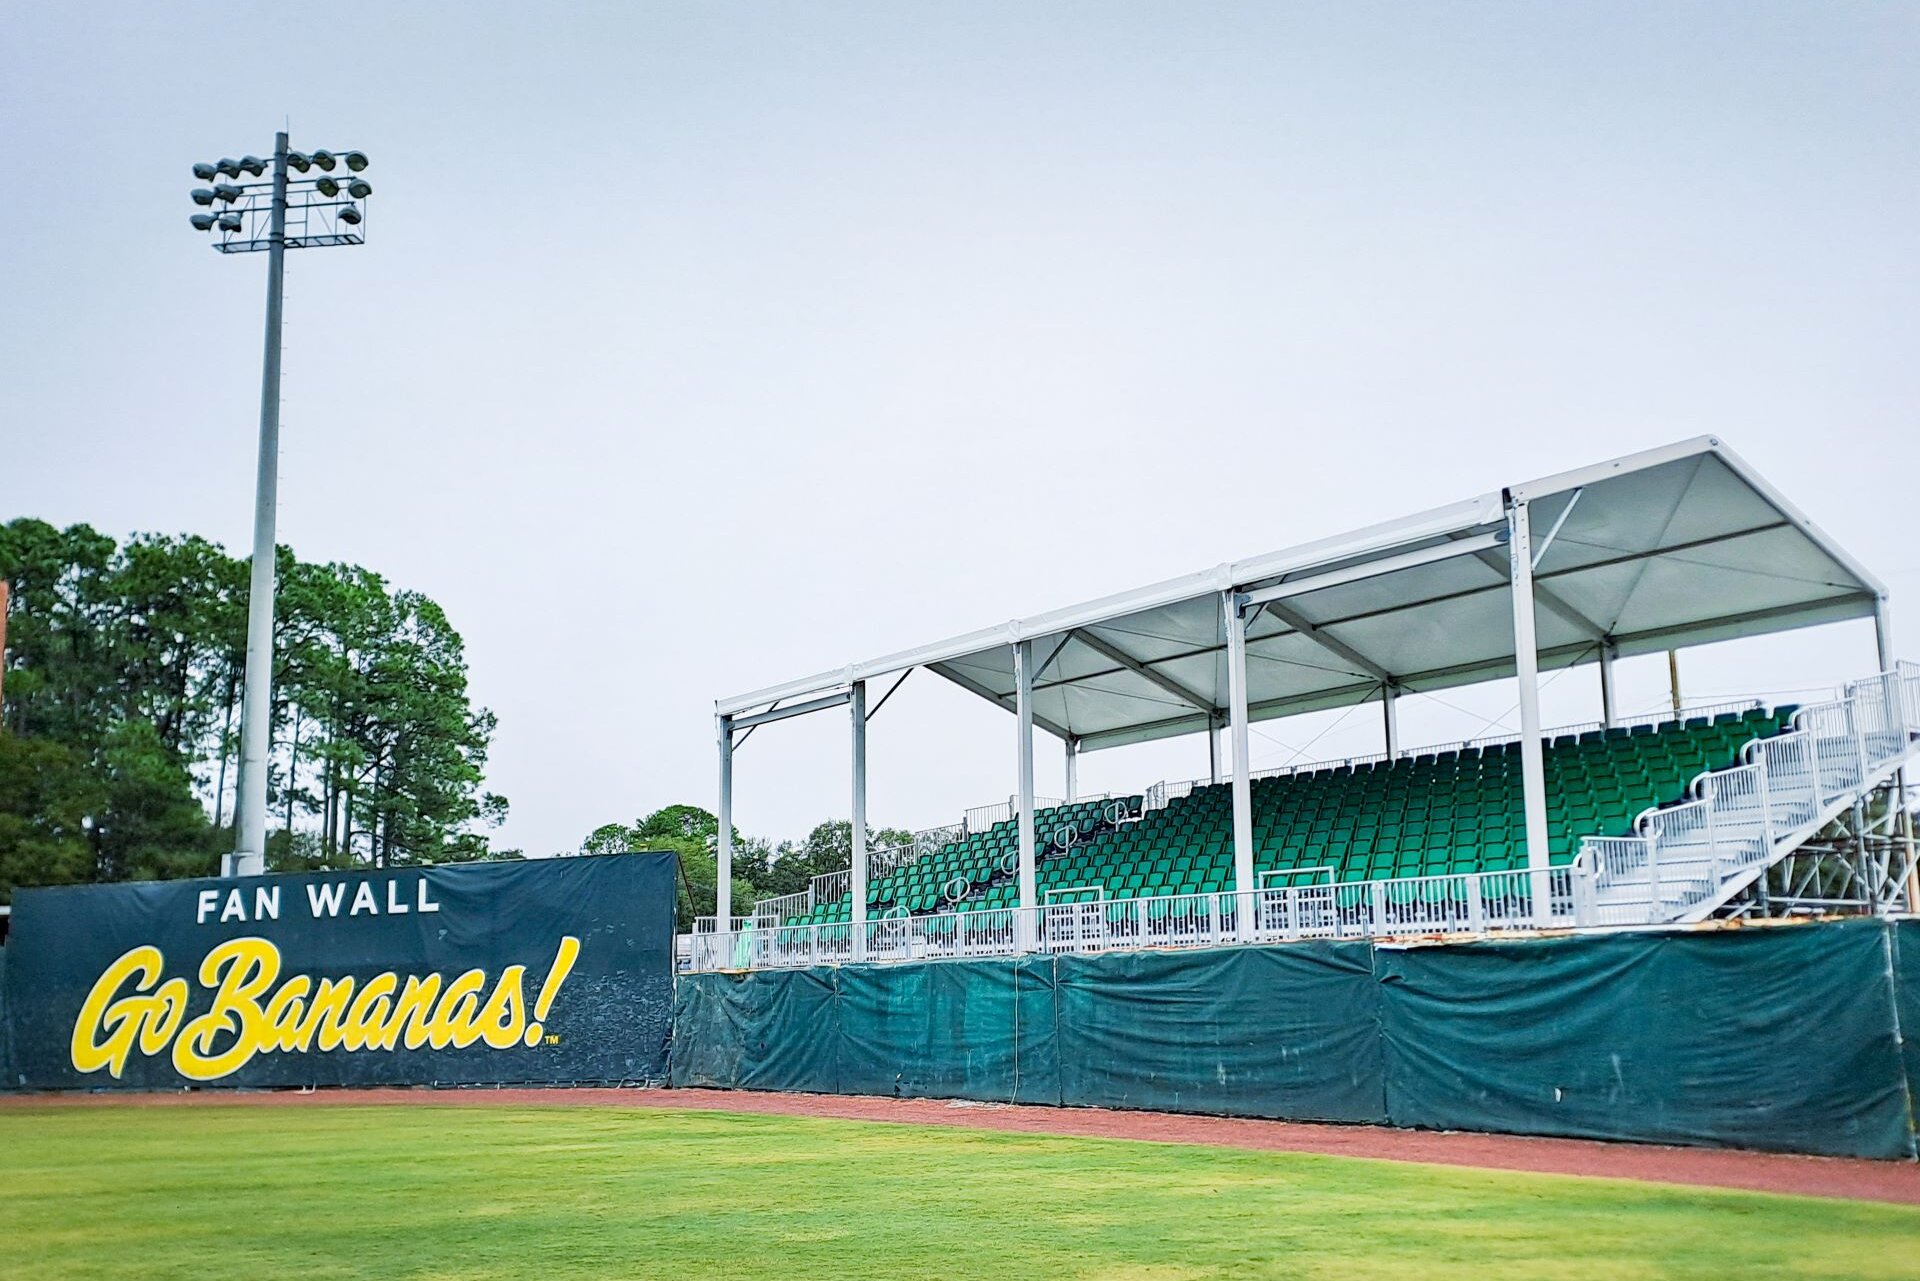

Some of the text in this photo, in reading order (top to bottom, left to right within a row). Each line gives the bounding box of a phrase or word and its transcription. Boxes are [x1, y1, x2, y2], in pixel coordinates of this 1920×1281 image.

[197, 878, 441, 924] FAN WALL
[70, 936, 581, 1081] Go Bananas!
